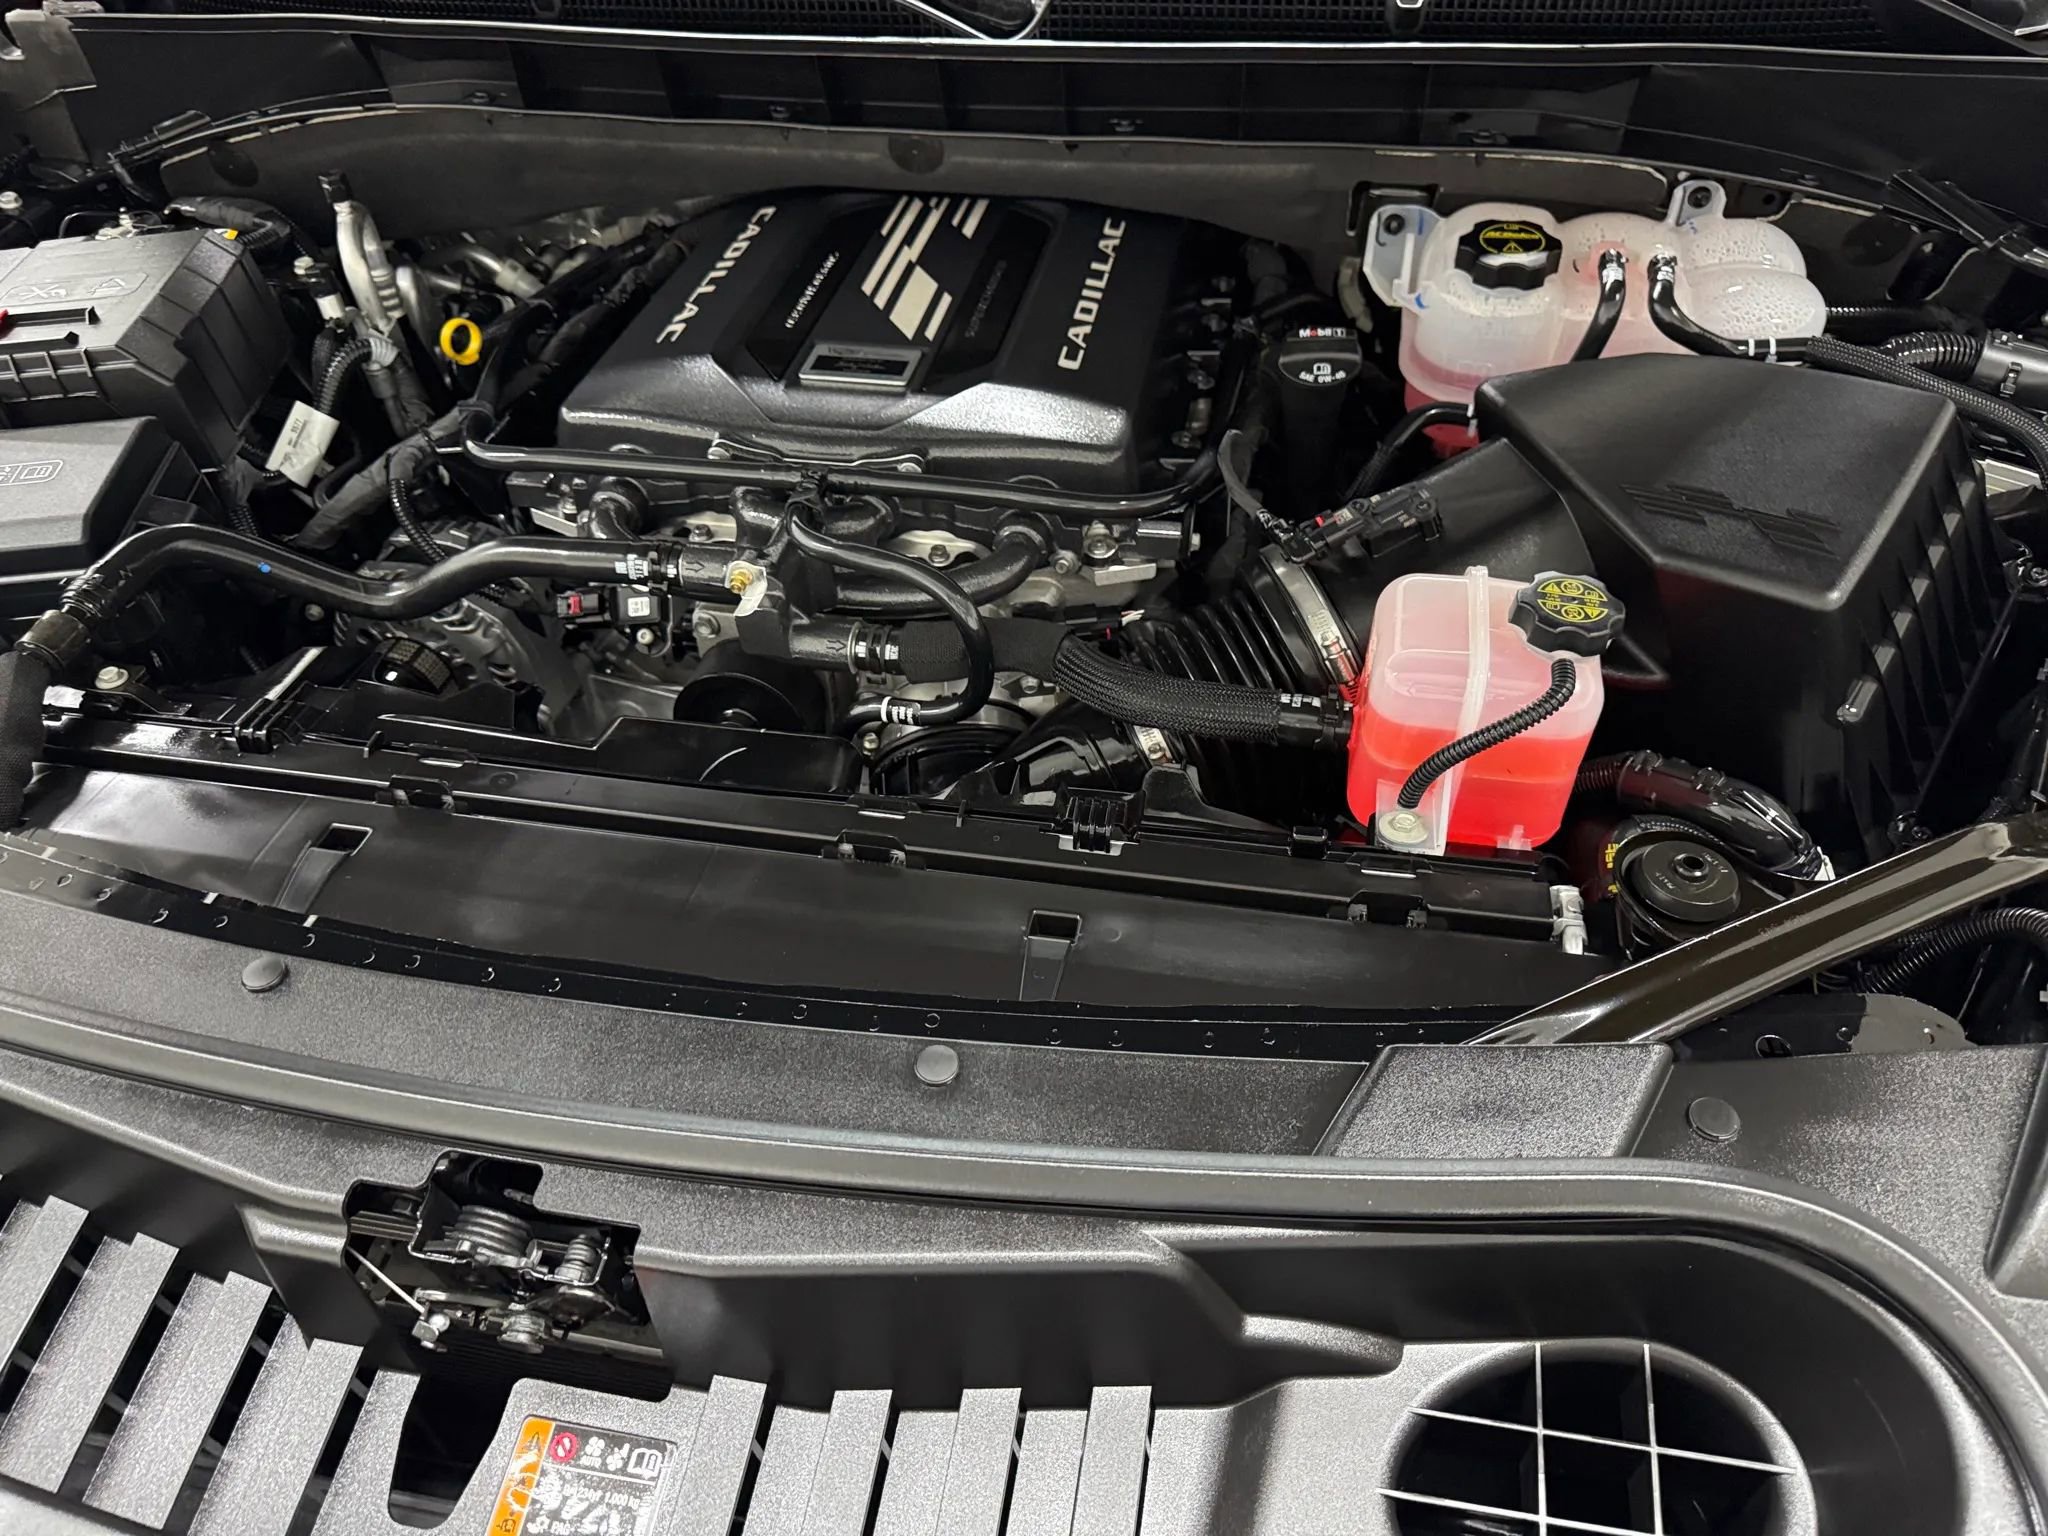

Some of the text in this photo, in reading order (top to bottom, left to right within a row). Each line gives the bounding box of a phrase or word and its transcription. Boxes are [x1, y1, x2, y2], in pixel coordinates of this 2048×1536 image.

[656, 206, 777, 344] CADILLAC
[1057, 217, 1126, 370] CADILLAC
[1299, 327, 1332, 338] Mobil
[1299, 371, 1315, 382] SAE
